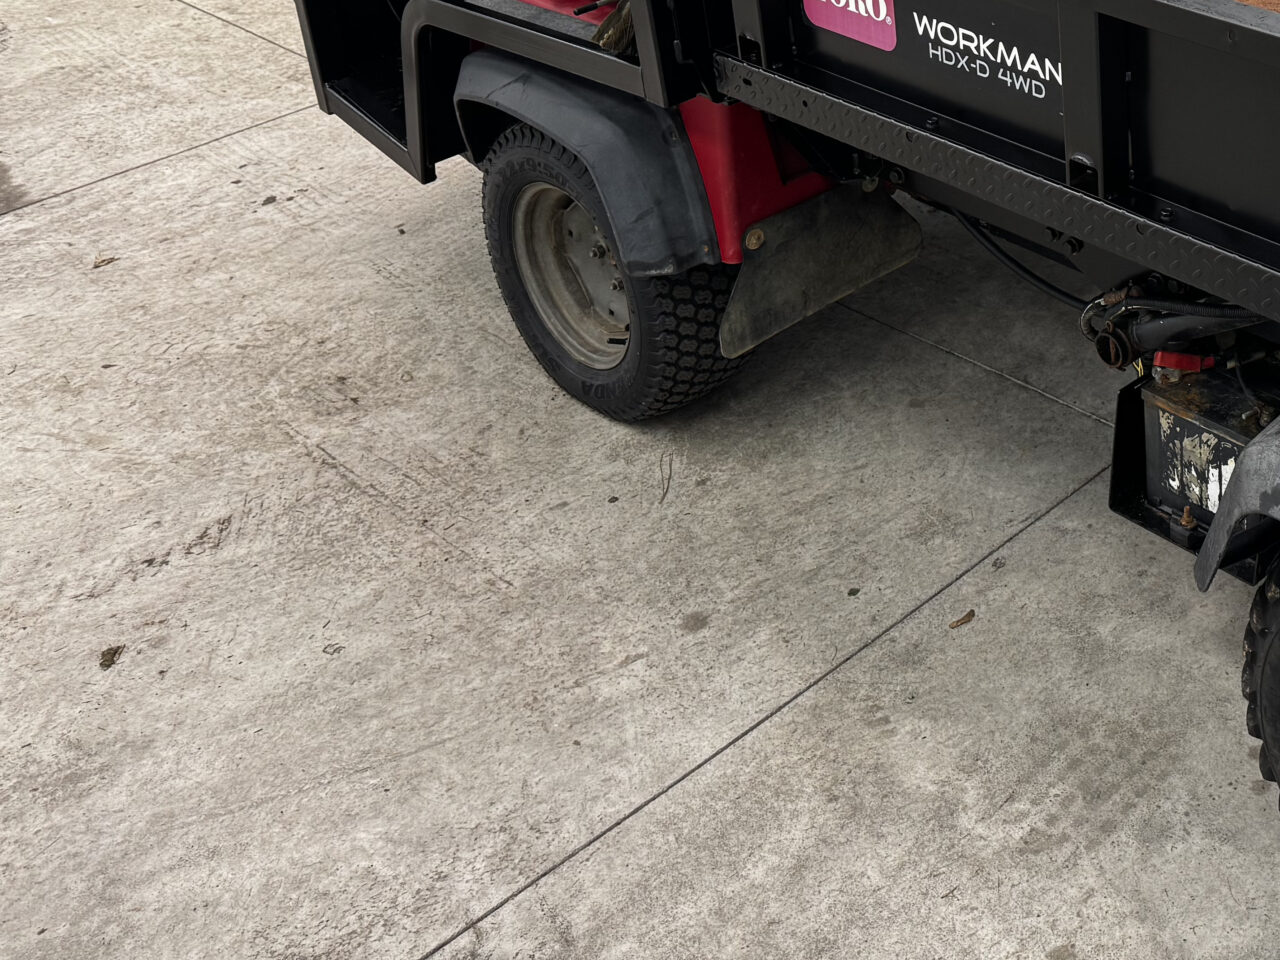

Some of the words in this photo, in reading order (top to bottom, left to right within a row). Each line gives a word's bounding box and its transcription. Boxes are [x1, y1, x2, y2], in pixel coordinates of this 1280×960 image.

[912, 11, 1063, 86] WORKMAN
[928, 42, 990, 78] HDX-D
[997, 68, 1046, 99] 4WD
